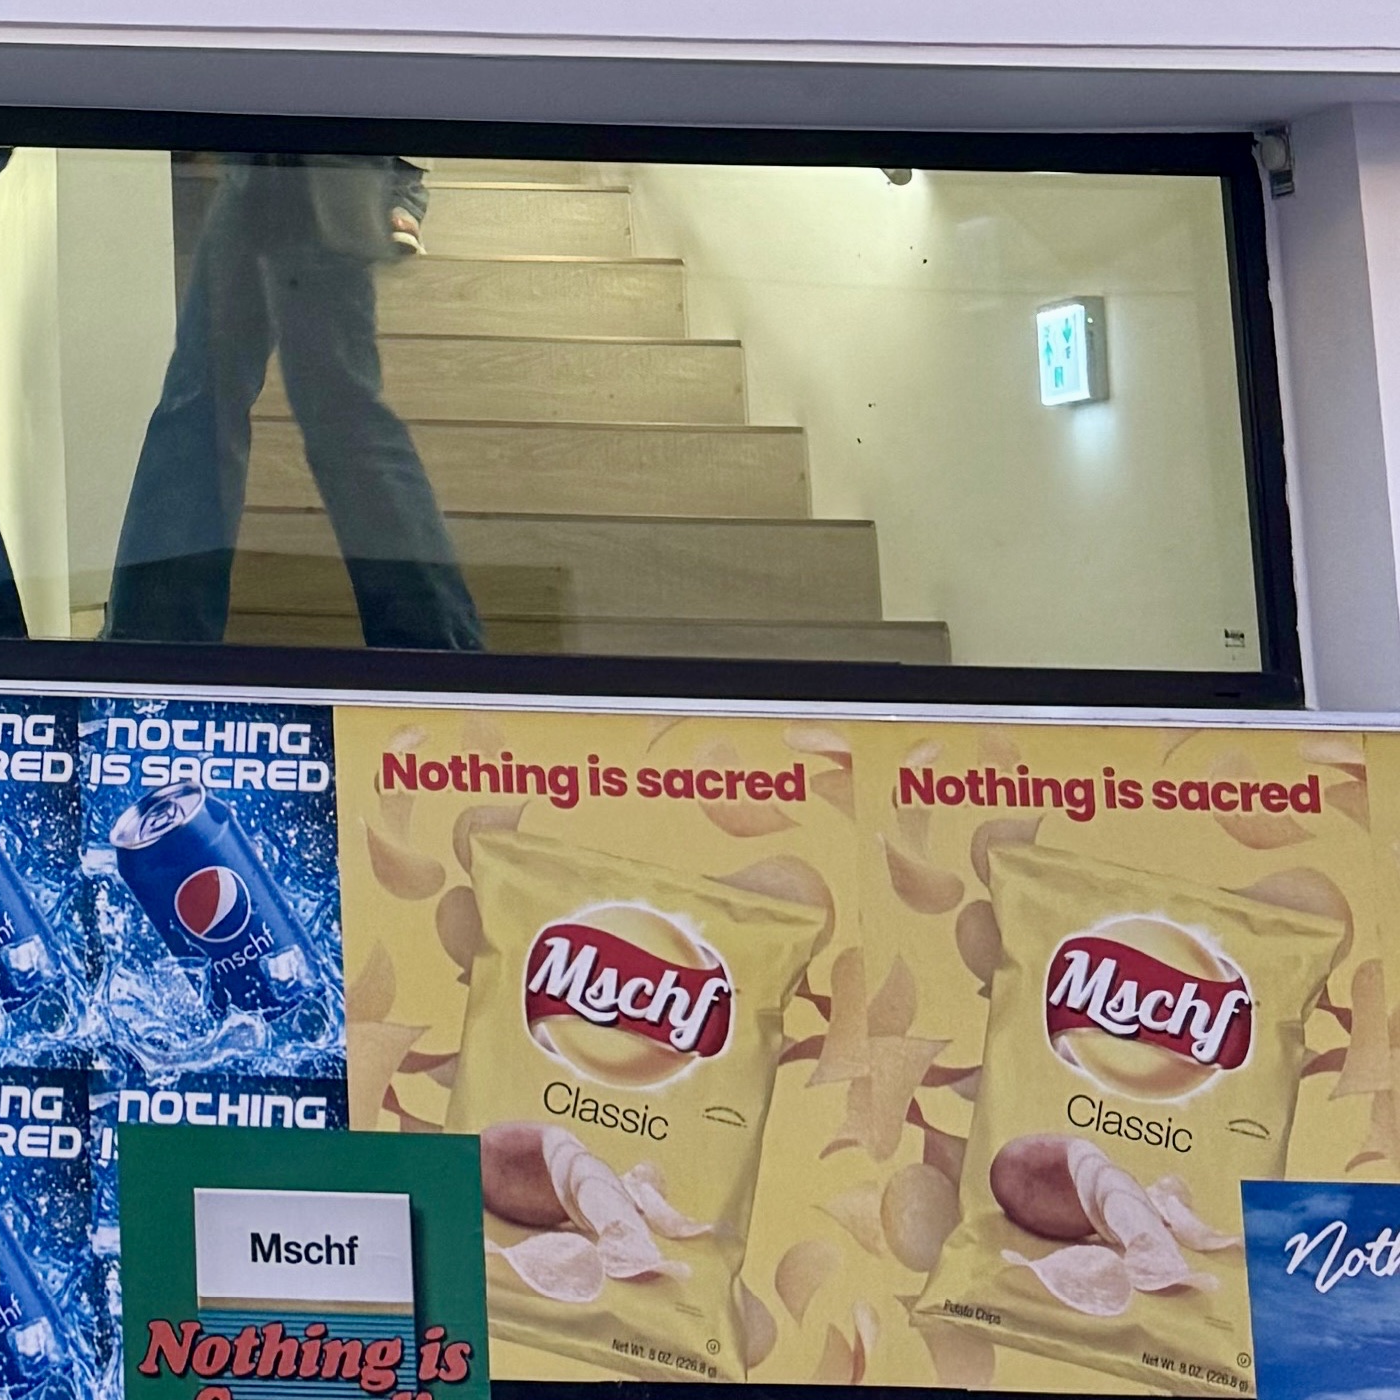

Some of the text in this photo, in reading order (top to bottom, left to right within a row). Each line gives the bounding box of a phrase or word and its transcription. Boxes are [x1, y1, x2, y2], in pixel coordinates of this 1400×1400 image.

[106, 717, 312, 755] NOTHING
[89, 753, 330, 793] IS SACRED
[381, 751, 807, 810] Nothing is sacred
[898, 764, 1323, 823] Nothing is sacred
[213, 921, 274, 977] mschf
[527, 936, 732, 1053] Mschf
[1047, 949, 1251, 1065] Mschf
[117, 1090, 328, 1130] NOTHING
[543, 1080, 670, 1142] Classic
[1066, 1093, 1194, 1154] Classic
[250, 1232, 359, 1266] Mschf
[137, 1318, 473, 1393] Nothing is
